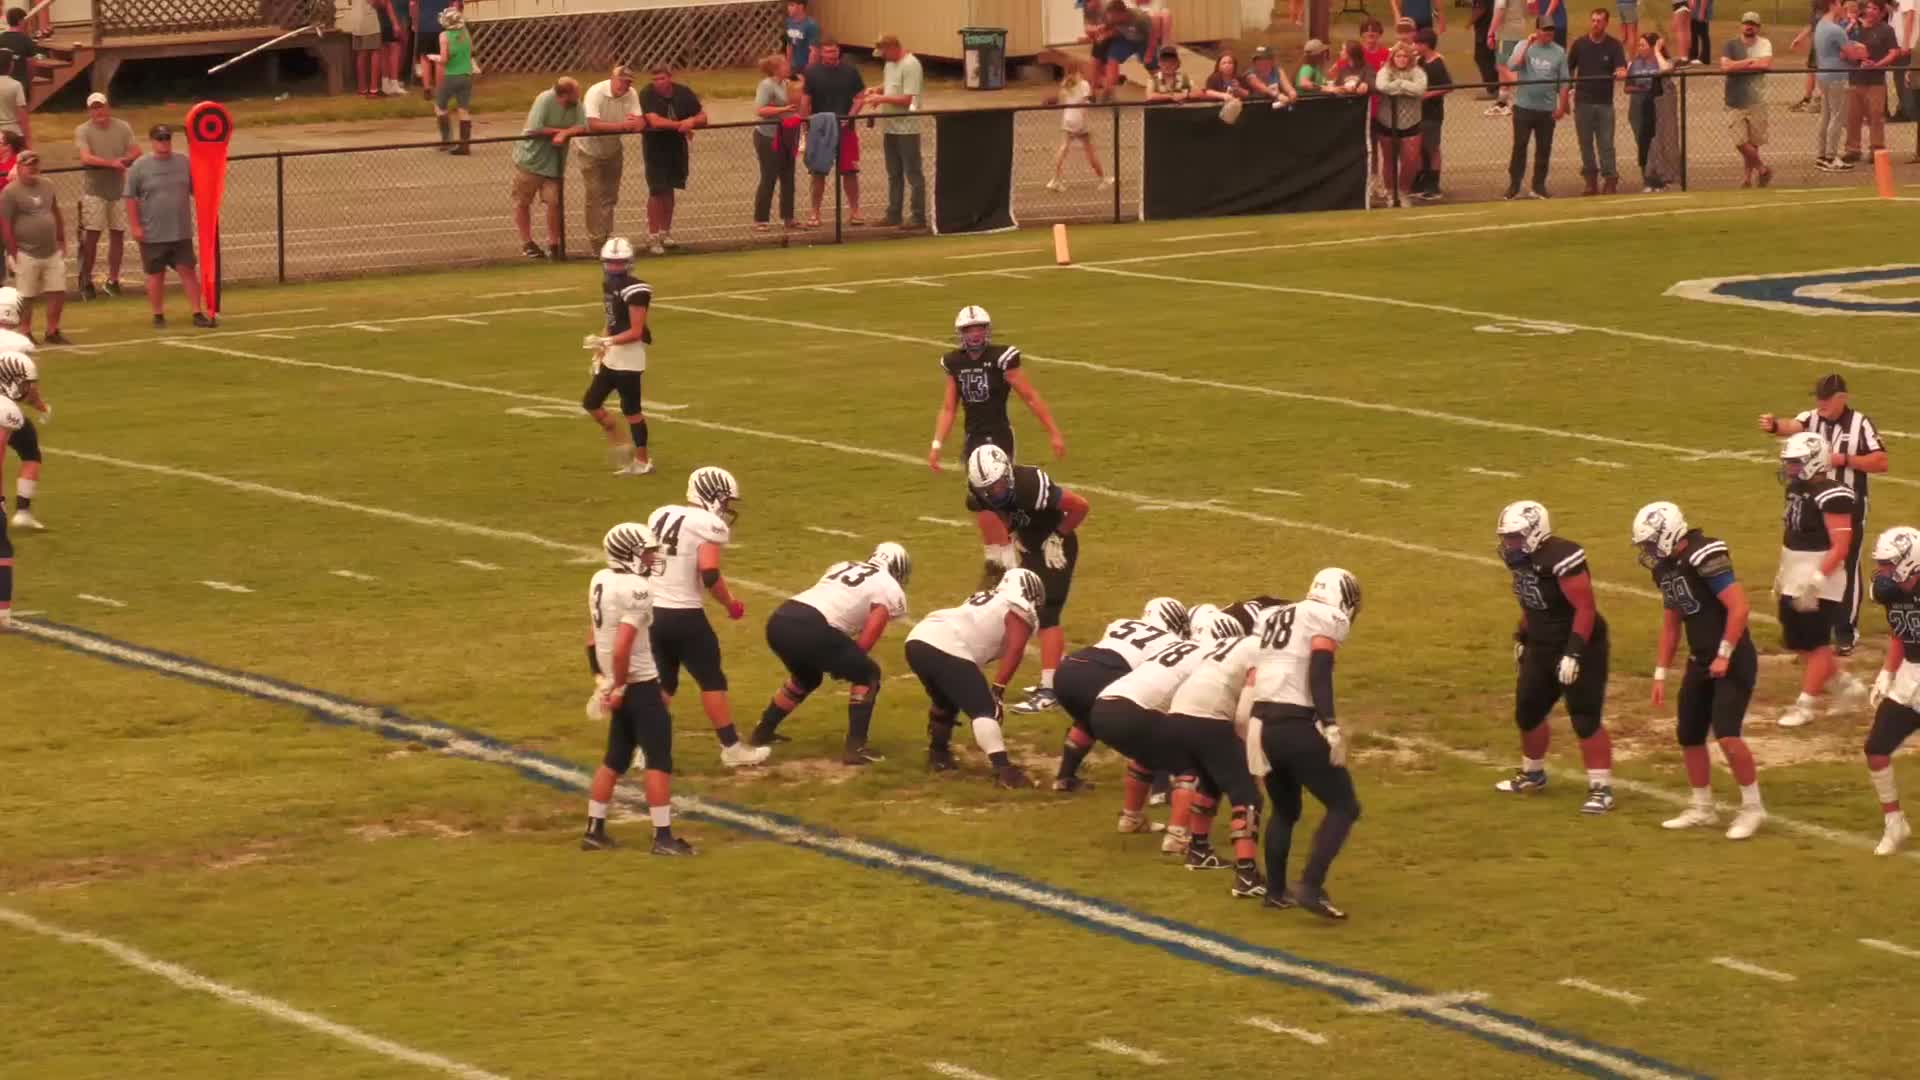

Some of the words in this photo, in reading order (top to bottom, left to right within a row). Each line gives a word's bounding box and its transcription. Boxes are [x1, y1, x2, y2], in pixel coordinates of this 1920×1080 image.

[959, 371, 990, 403] 13
[651, 511, 686, 556] 44
[593, 583, 604, 628] 3
[1109, 620, 1168, 651] 57
[1260, 606, 1297, 650] 88
